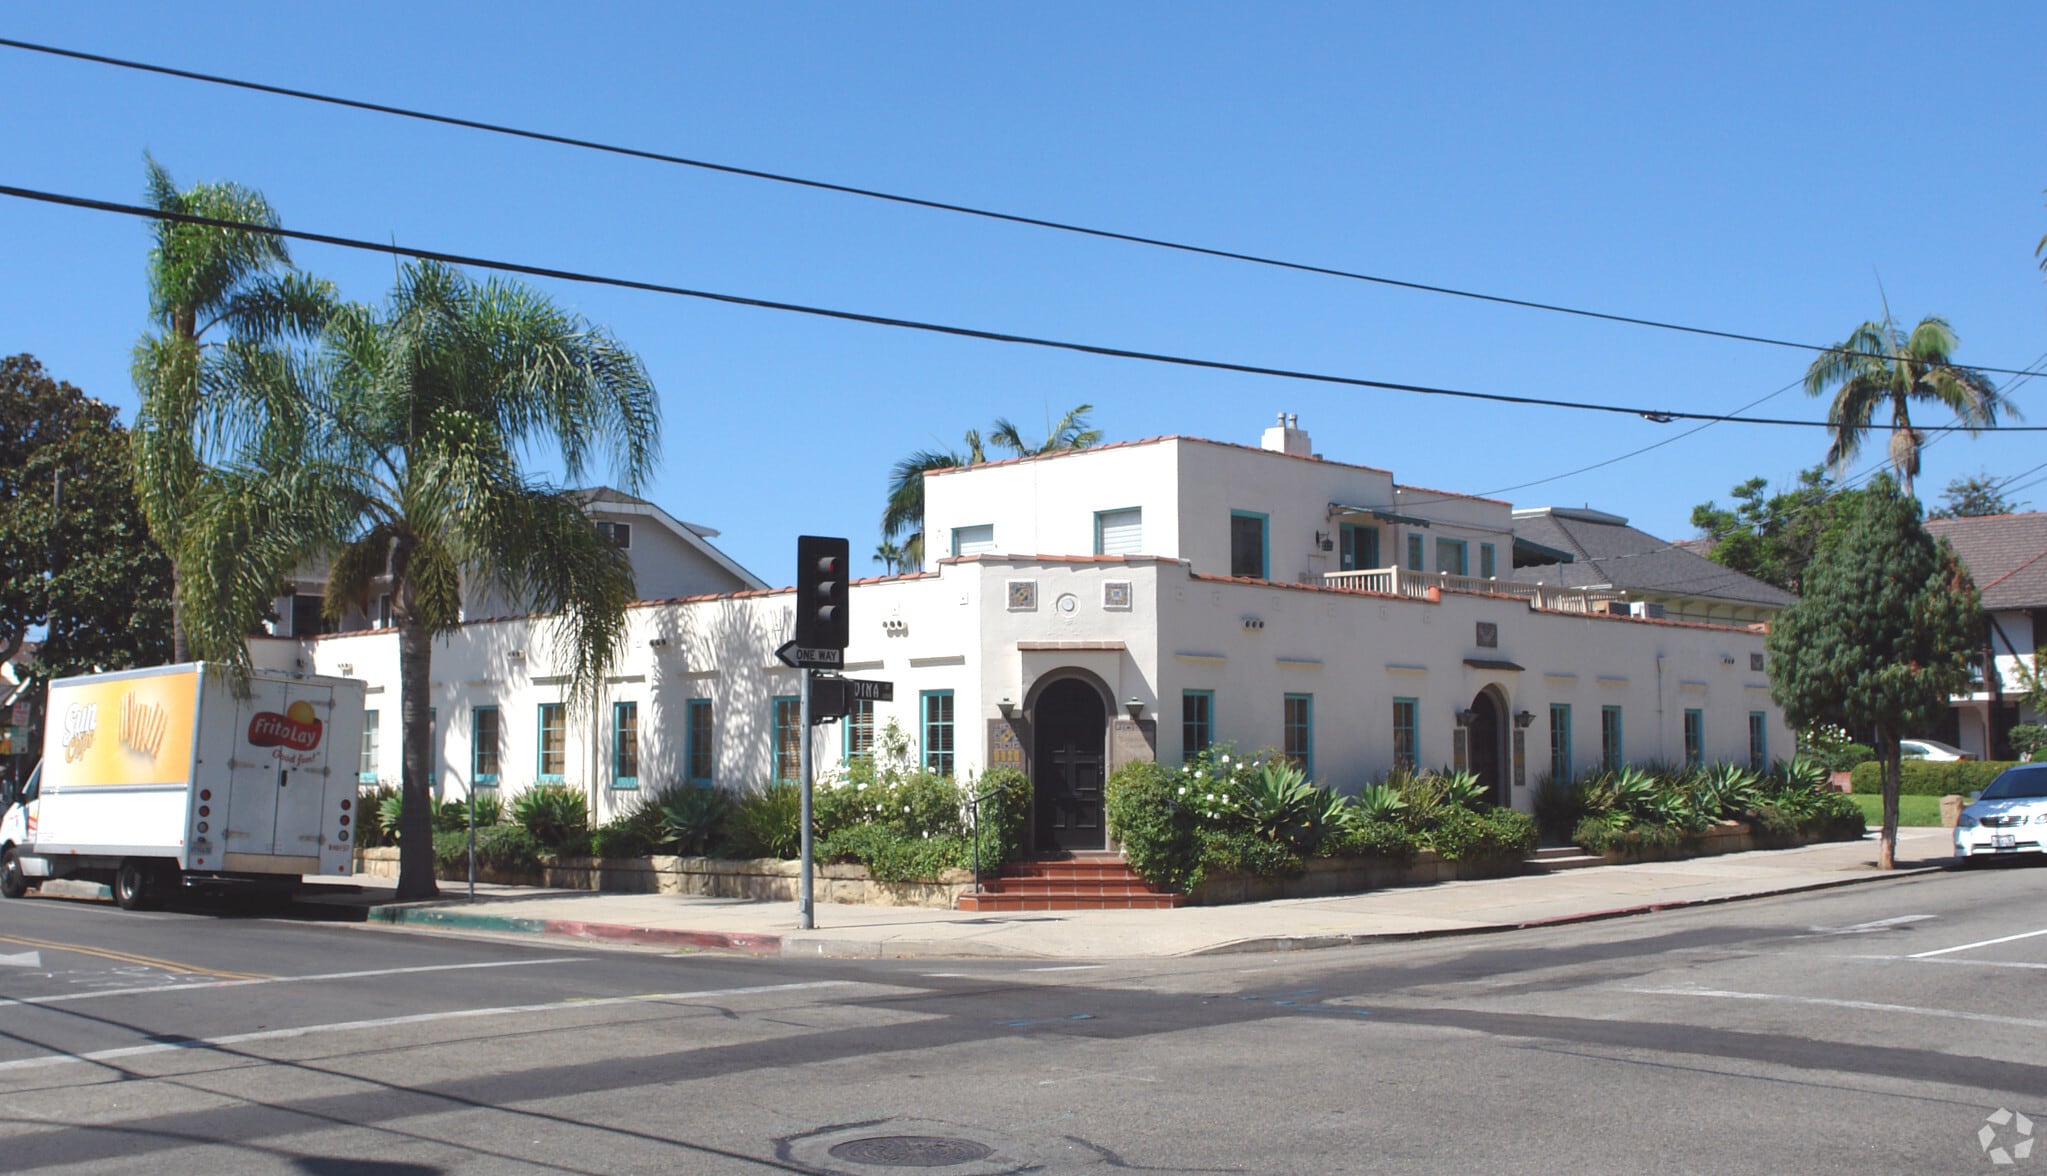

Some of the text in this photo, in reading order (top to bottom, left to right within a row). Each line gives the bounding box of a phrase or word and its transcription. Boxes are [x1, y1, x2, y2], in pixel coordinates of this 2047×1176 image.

[796, 650, 837, 661] ONE WAY
[62, 702, 97, 747] Sun
